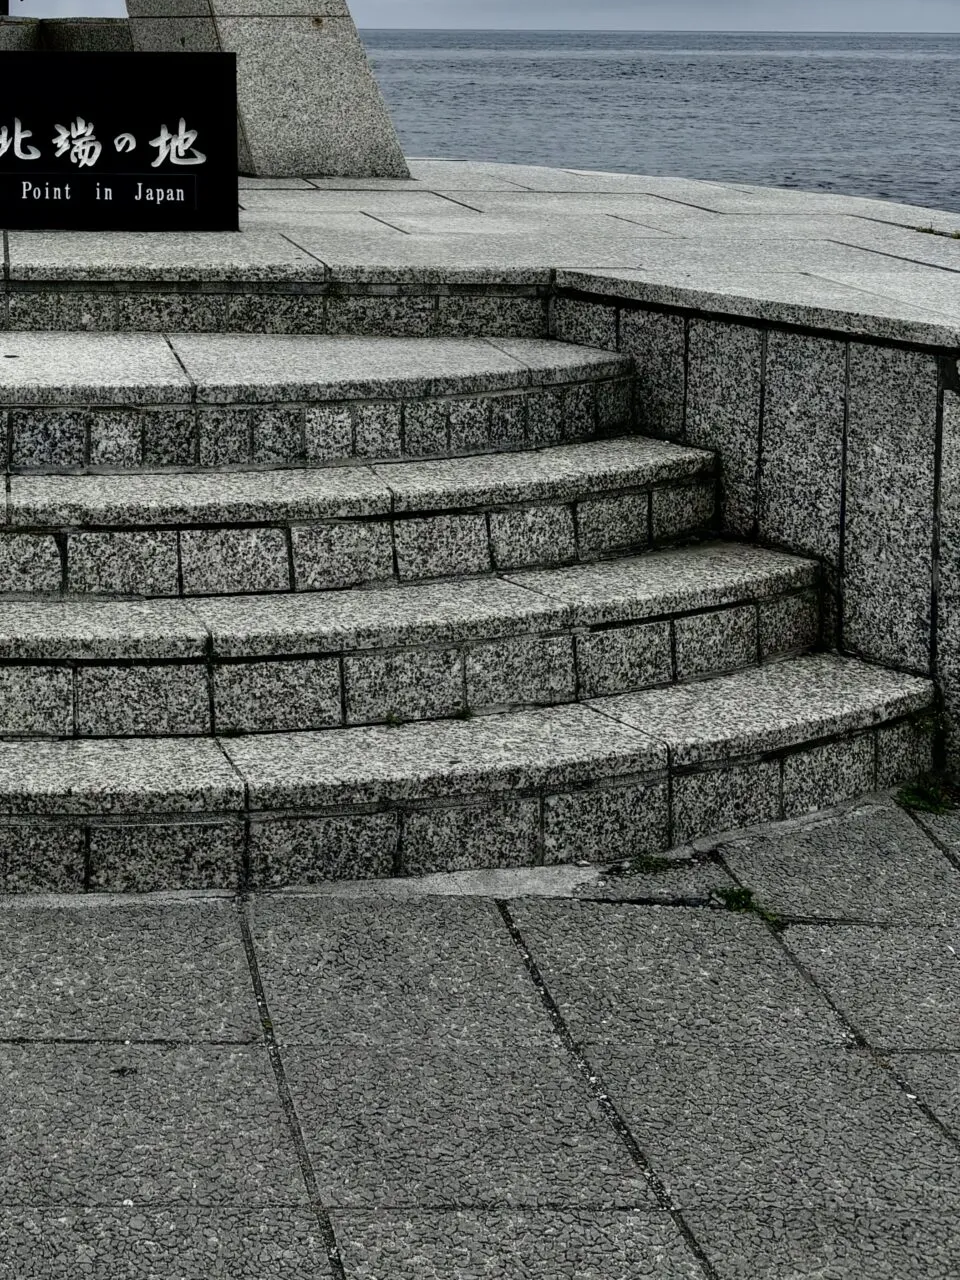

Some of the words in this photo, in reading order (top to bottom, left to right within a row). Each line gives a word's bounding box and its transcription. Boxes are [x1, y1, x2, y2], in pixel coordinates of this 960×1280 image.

[20, 181, 72, 200] Point
[95, 182, 114, 201] in
[133, 182, 186, 206] Japan
